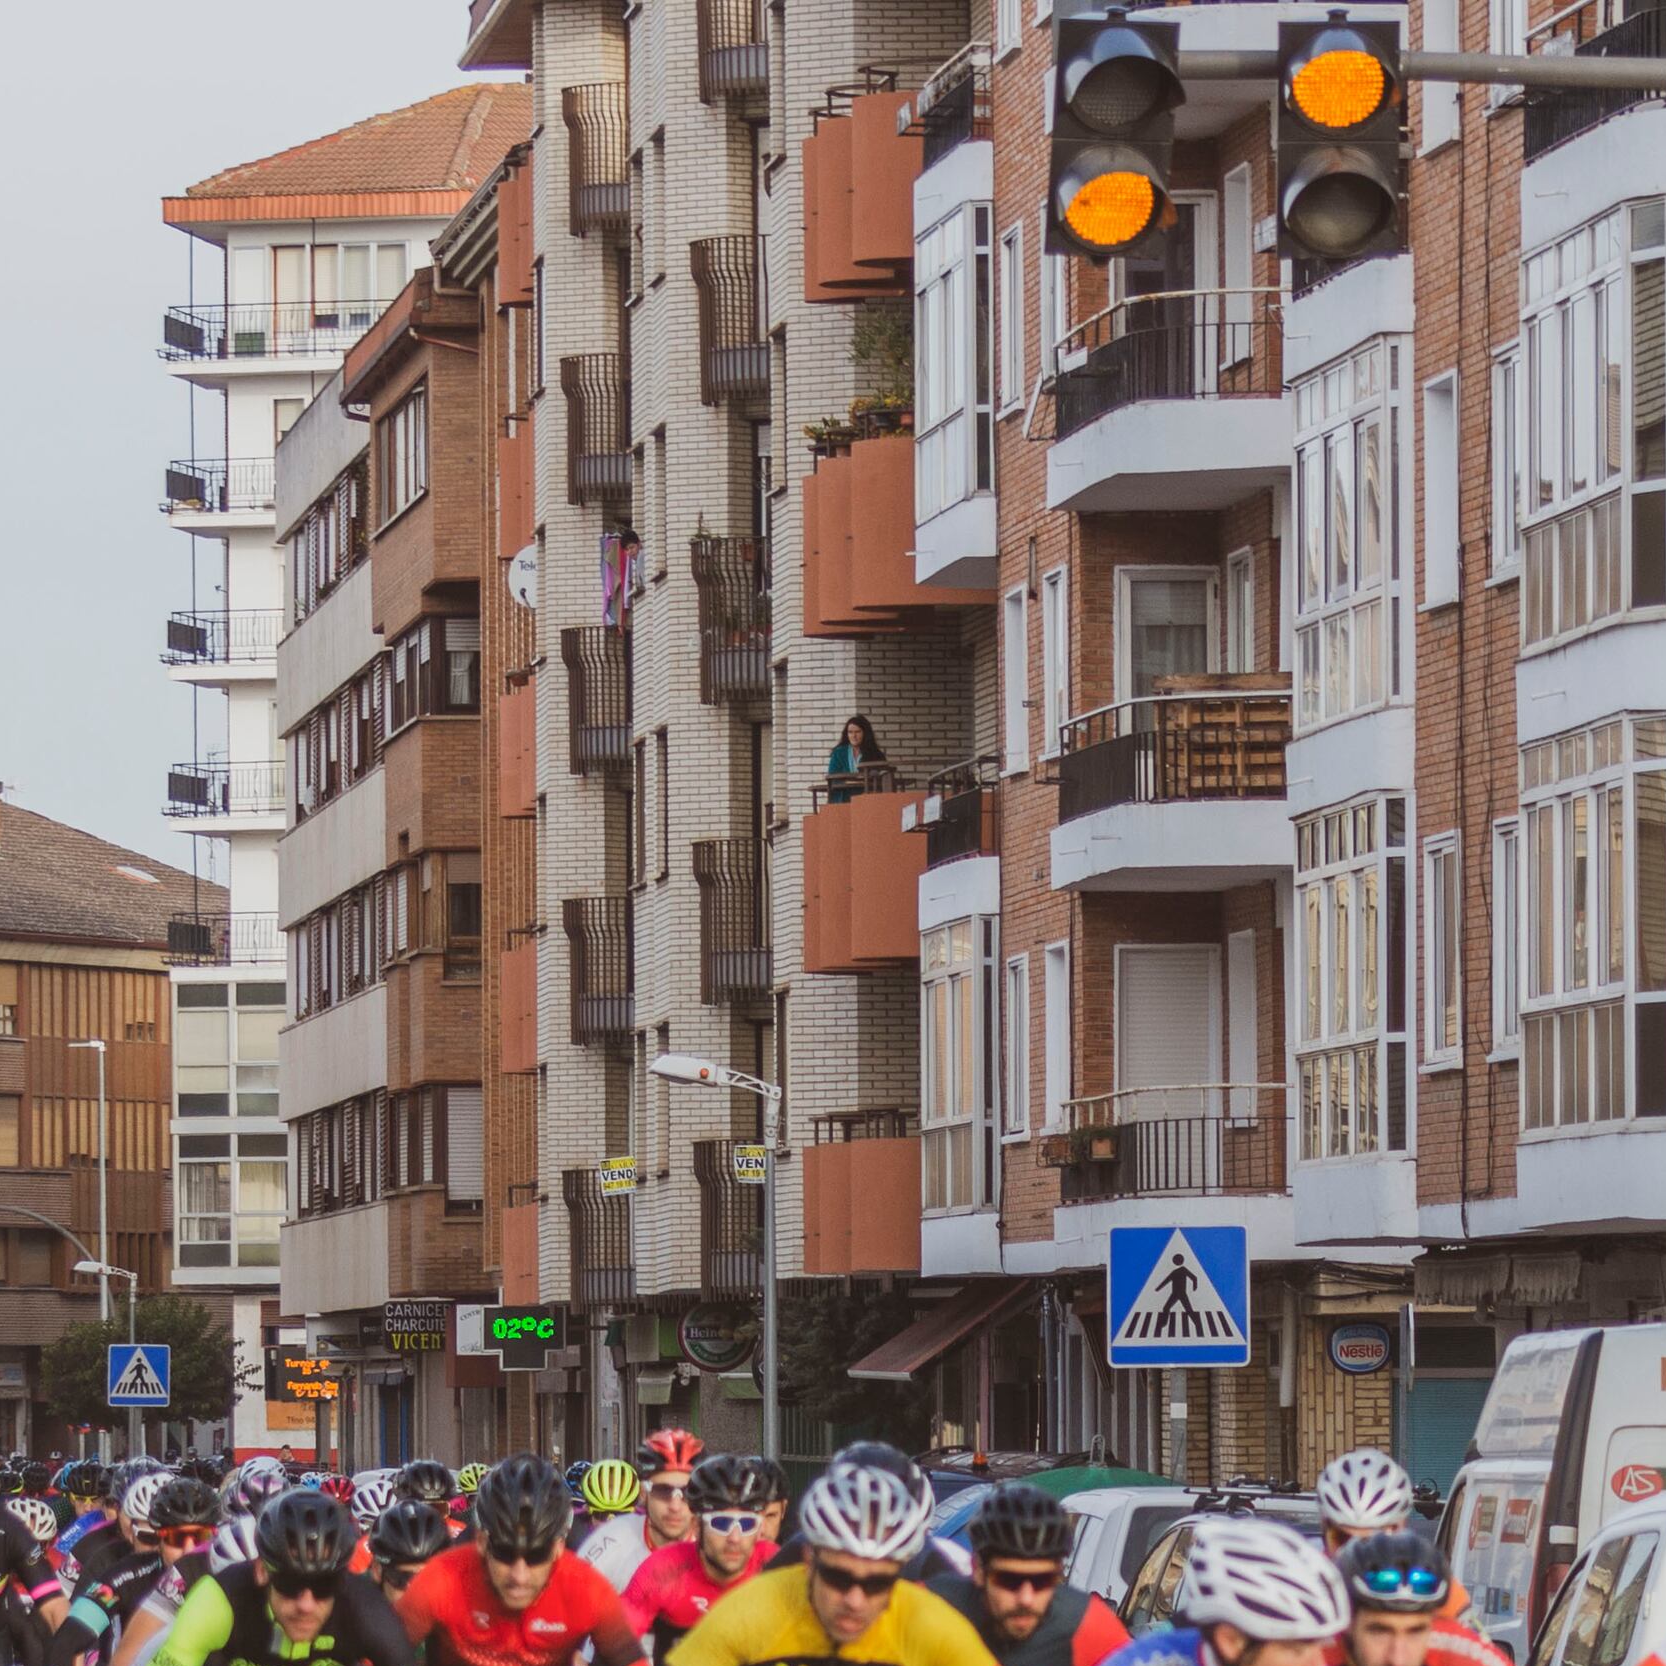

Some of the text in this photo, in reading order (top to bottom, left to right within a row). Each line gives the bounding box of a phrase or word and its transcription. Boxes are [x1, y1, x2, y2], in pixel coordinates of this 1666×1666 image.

[736, 1158, 765, 1169] VEN
[385, 1319, 446, 1332] CHARCUTE
[1620, 1467, 1655, 1497] AS
